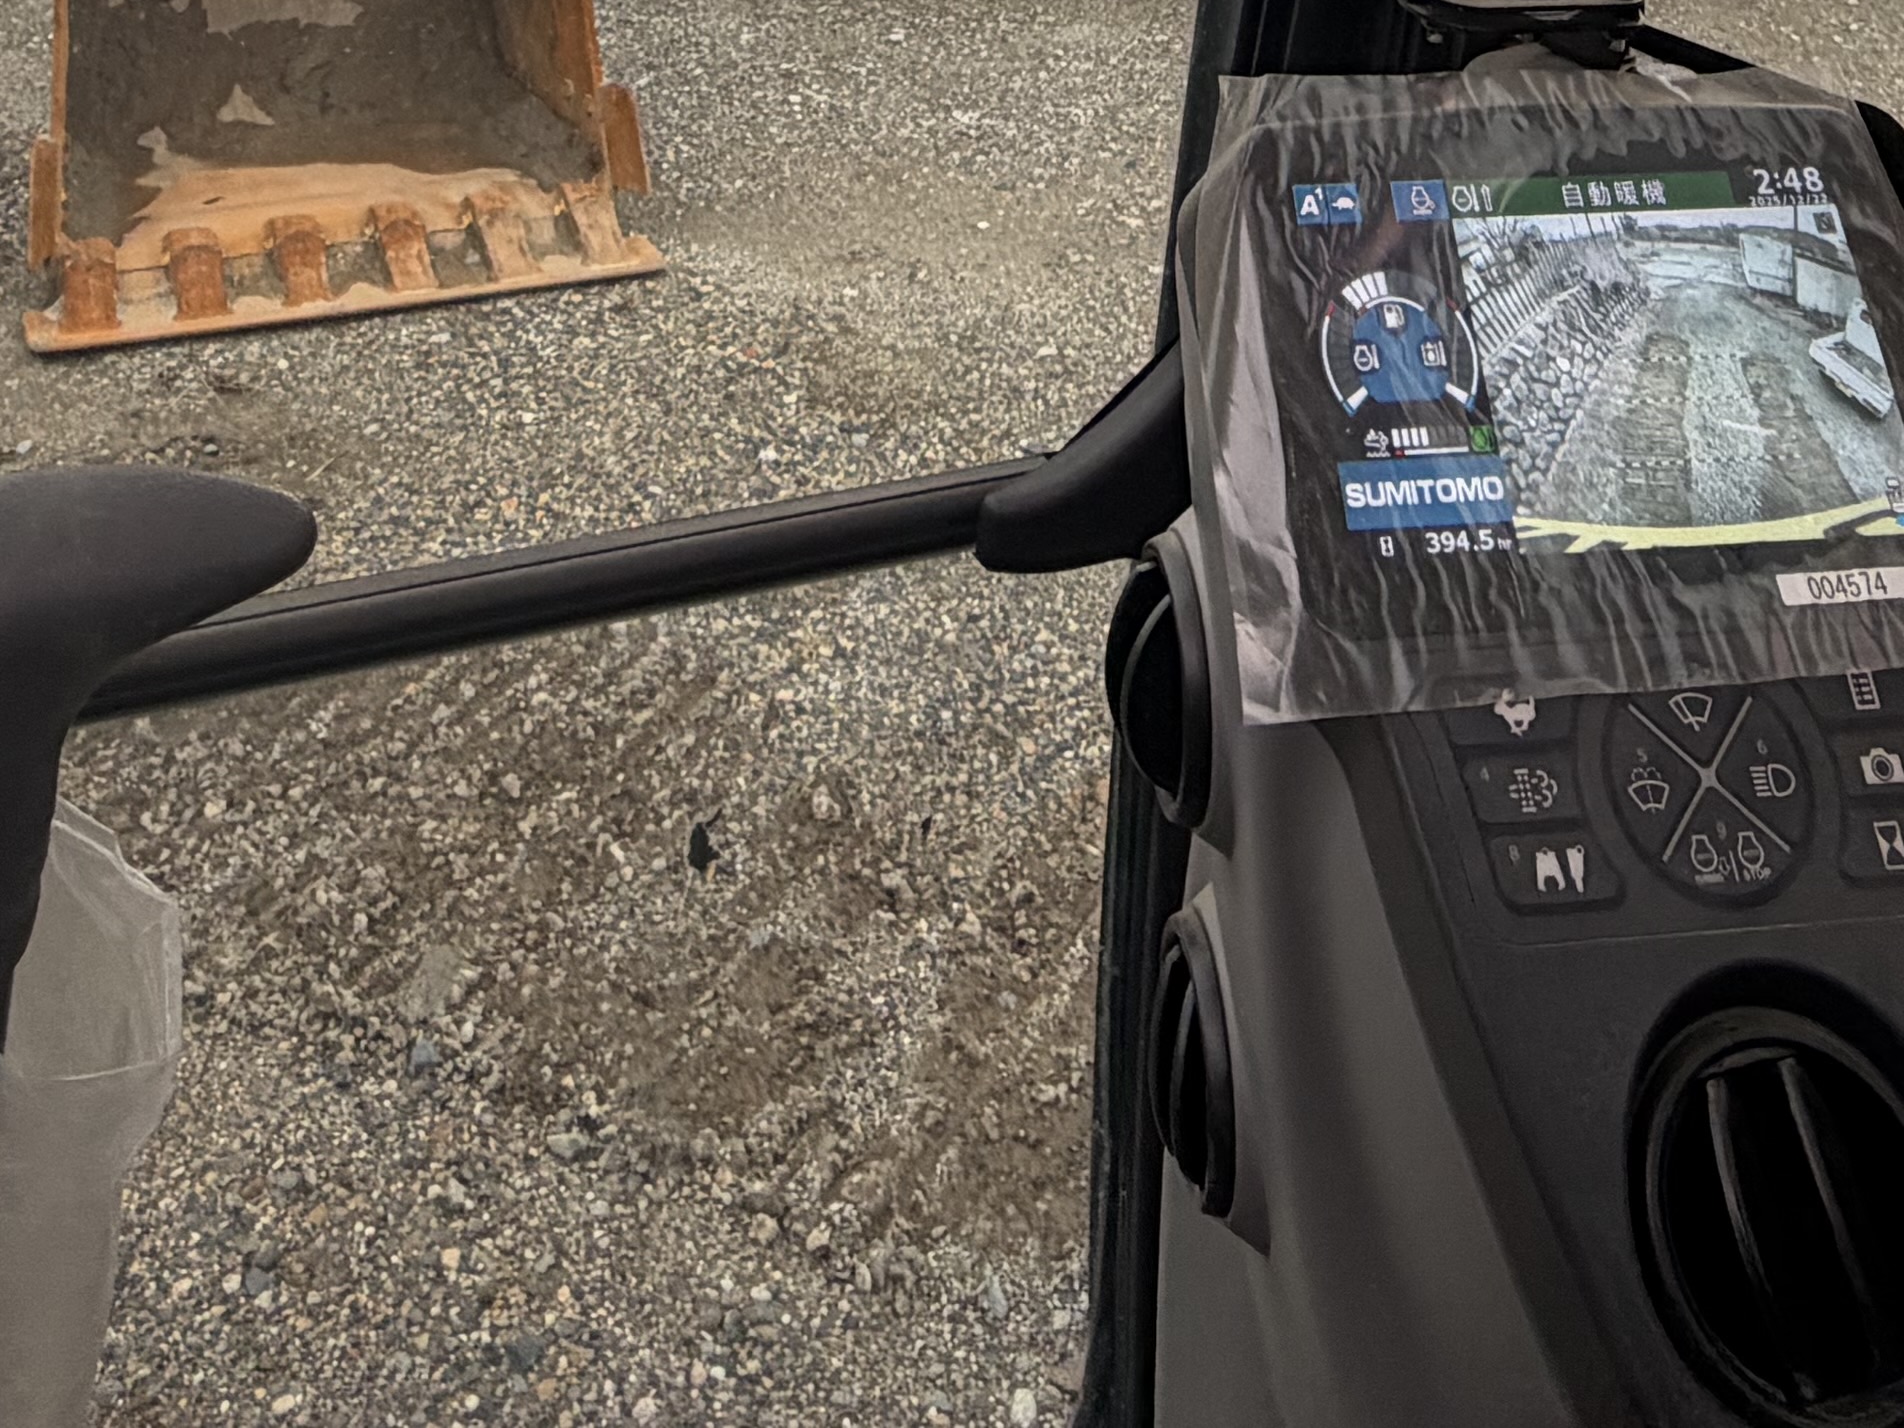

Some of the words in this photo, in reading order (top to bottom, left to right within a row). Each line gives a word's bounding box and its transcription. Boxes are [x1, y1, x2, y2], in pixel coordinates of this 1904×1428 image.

[1561, 178, 1668, 209] 自動暖機
[1752, 166, 1825, 195] 2:48
[1345, 475, 1505, 508] SUMITOMO
[1424, 529, 1495, 554] 394.5
[1806, 571, 1888, 600] 004574
[1756, 738, 1769, 755] 6
